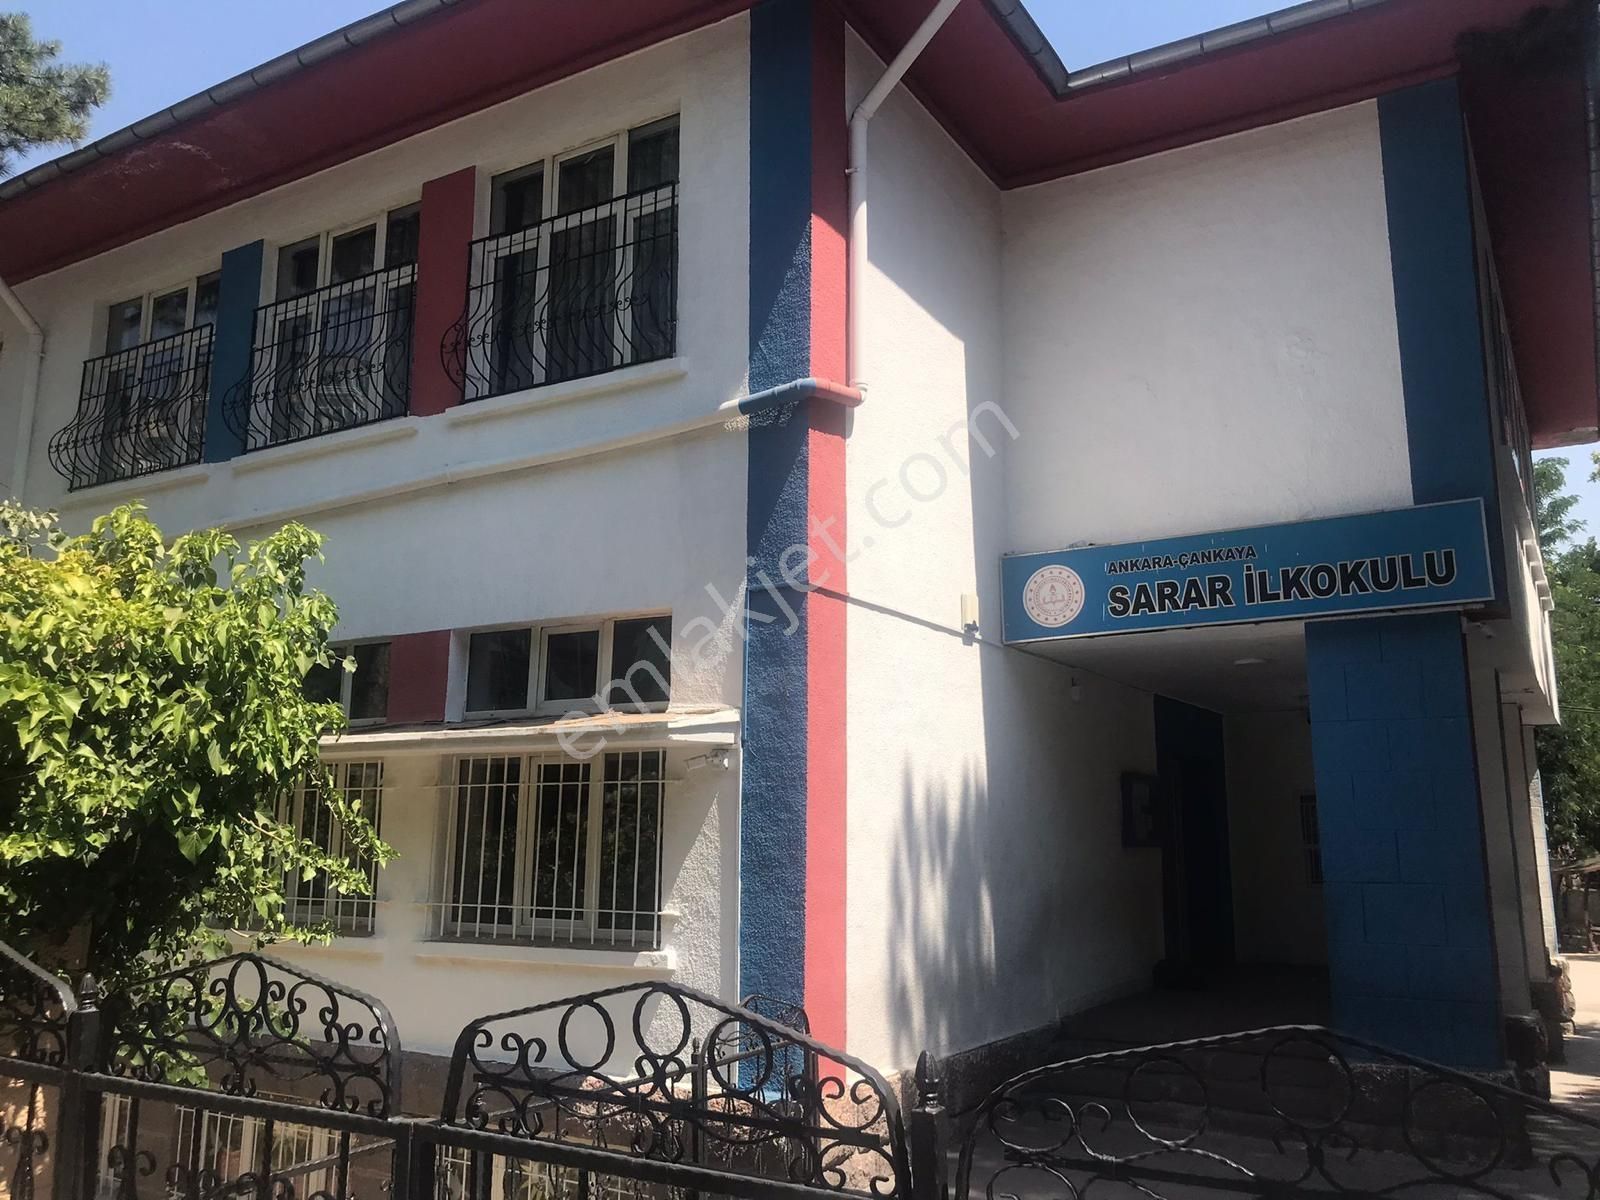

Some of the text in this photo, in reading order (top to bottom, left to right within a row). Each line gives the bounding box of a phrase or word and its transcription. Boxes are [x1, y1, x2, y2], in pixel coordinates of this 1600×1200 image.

[1107, 545, 1257, 574] ANKARA-ÇANKAYA
[1108, 574, 1235, 618] SARAR
[1244, 549, 1456, 605] İLKOKULU
